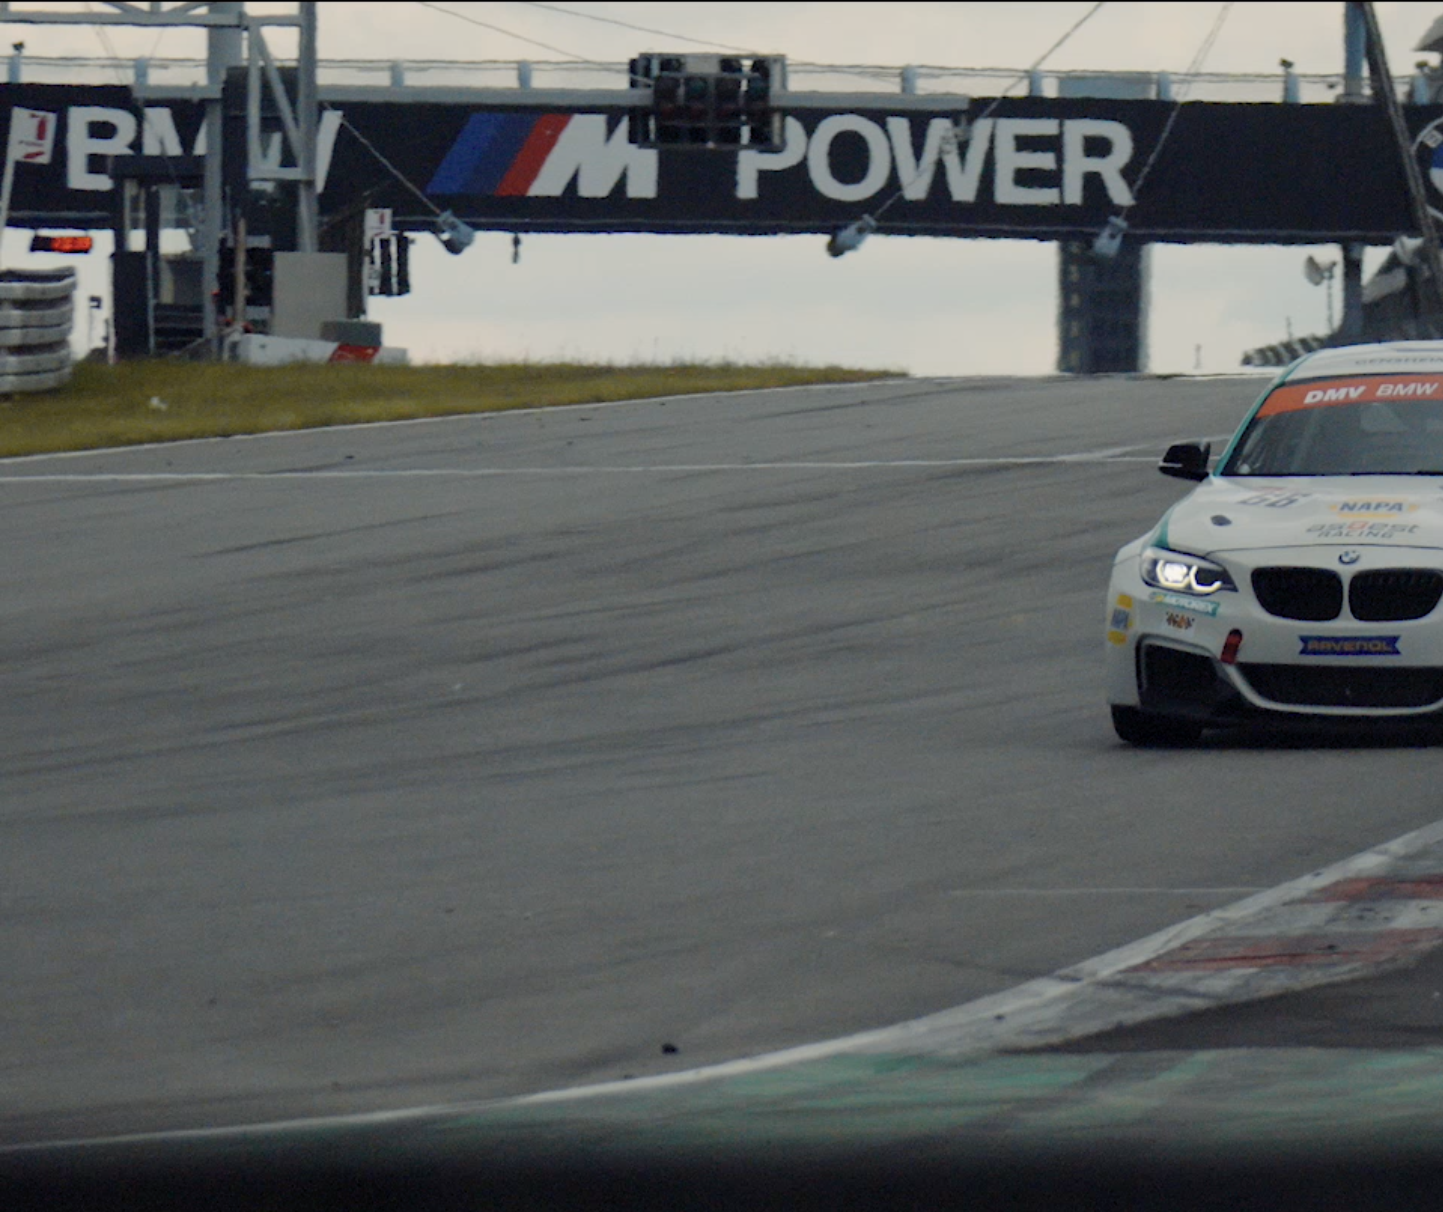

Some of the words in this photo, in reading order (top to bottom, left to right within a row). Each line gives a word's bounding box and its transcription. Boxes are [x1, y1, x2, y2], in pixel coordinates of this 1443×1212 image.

[736, 113, 1135, 206] POWER
[1303, 385, 1367, 404] DMV
[1376, 382, 1439, 398] BMW
[1338, 501, 1404, 513] NAPA
[1317, 530, 1396, 539] RACING
[1307, 640, 1393, 653] RAVENOL
